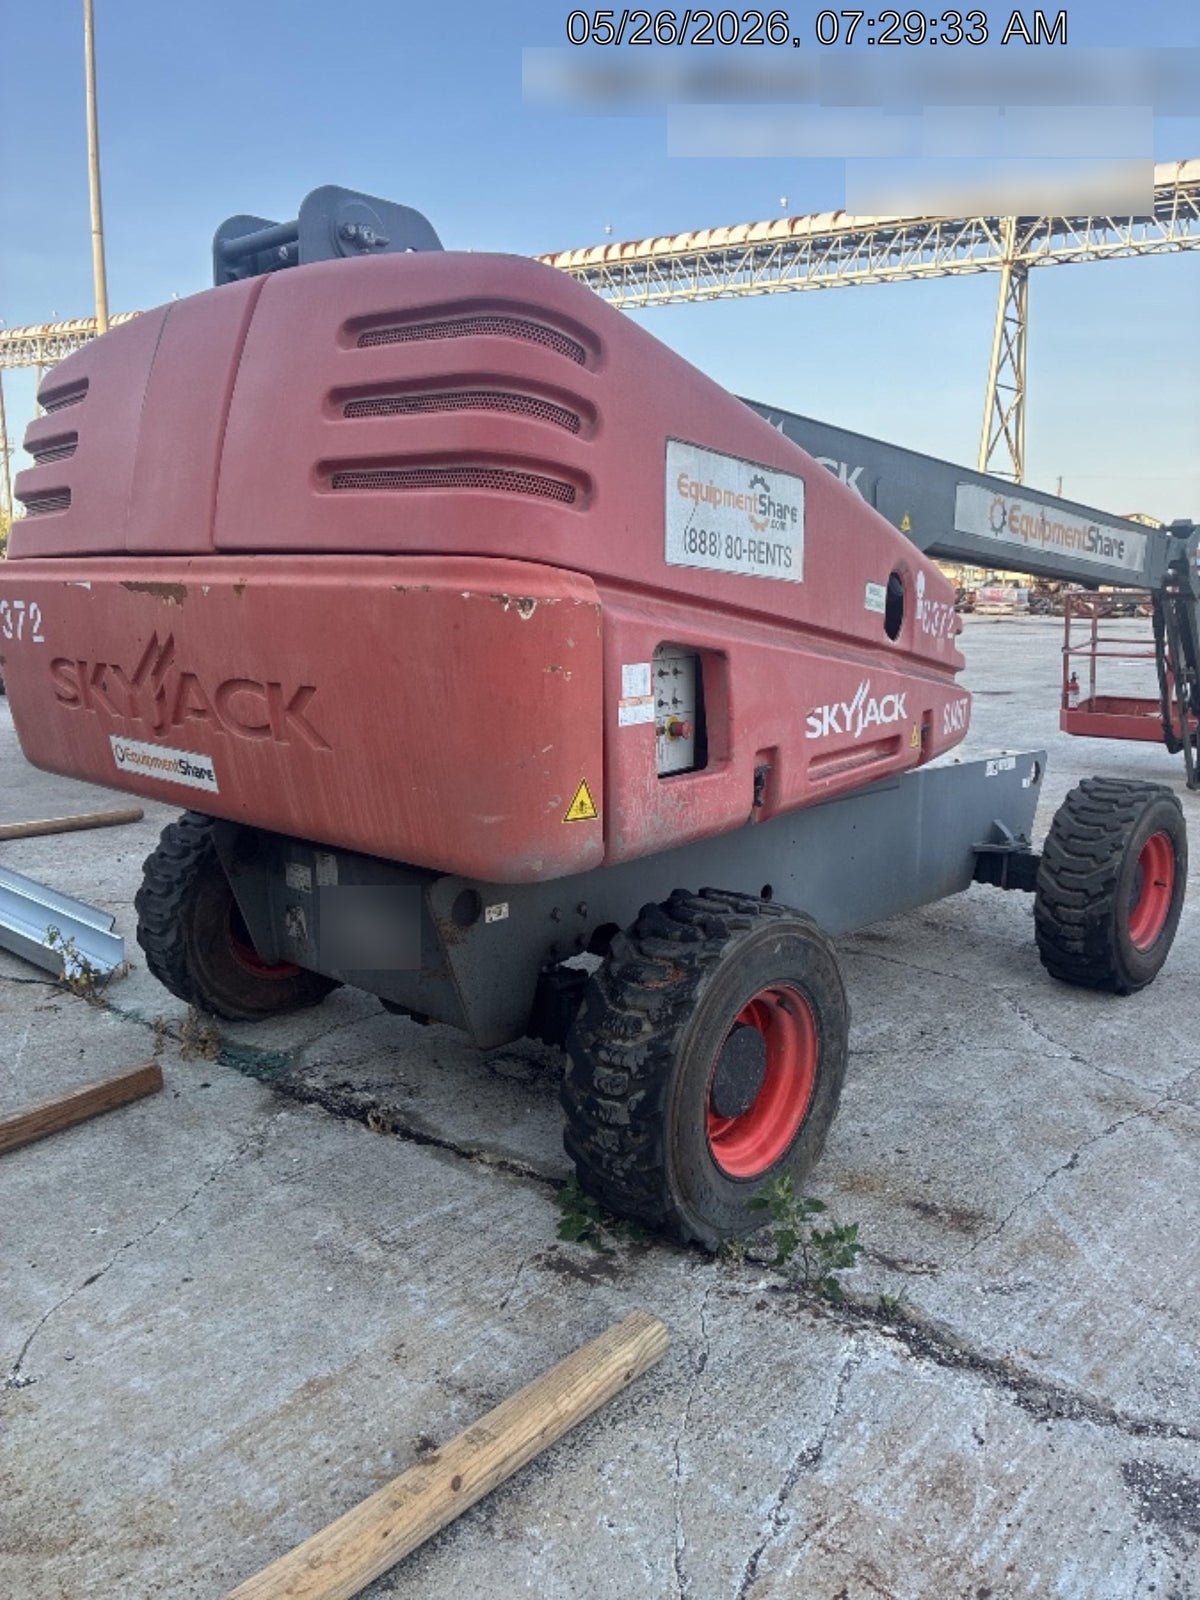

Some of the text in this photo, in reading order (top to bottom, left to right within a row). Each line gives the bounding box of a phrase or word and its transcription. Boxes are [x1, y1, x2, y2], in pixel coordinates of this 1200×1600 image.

[676, 472, 798, 523] EquipmentShare
[724, 533, 793, 569] 80-RENTS
[1007, 503, 1125, 560] EquipmentShare
[50, 630, 333, 752] SKYJACK
[805, 679, 908, 740] SKYJACK
[124, 747, 215, 782] EquipmentShare
